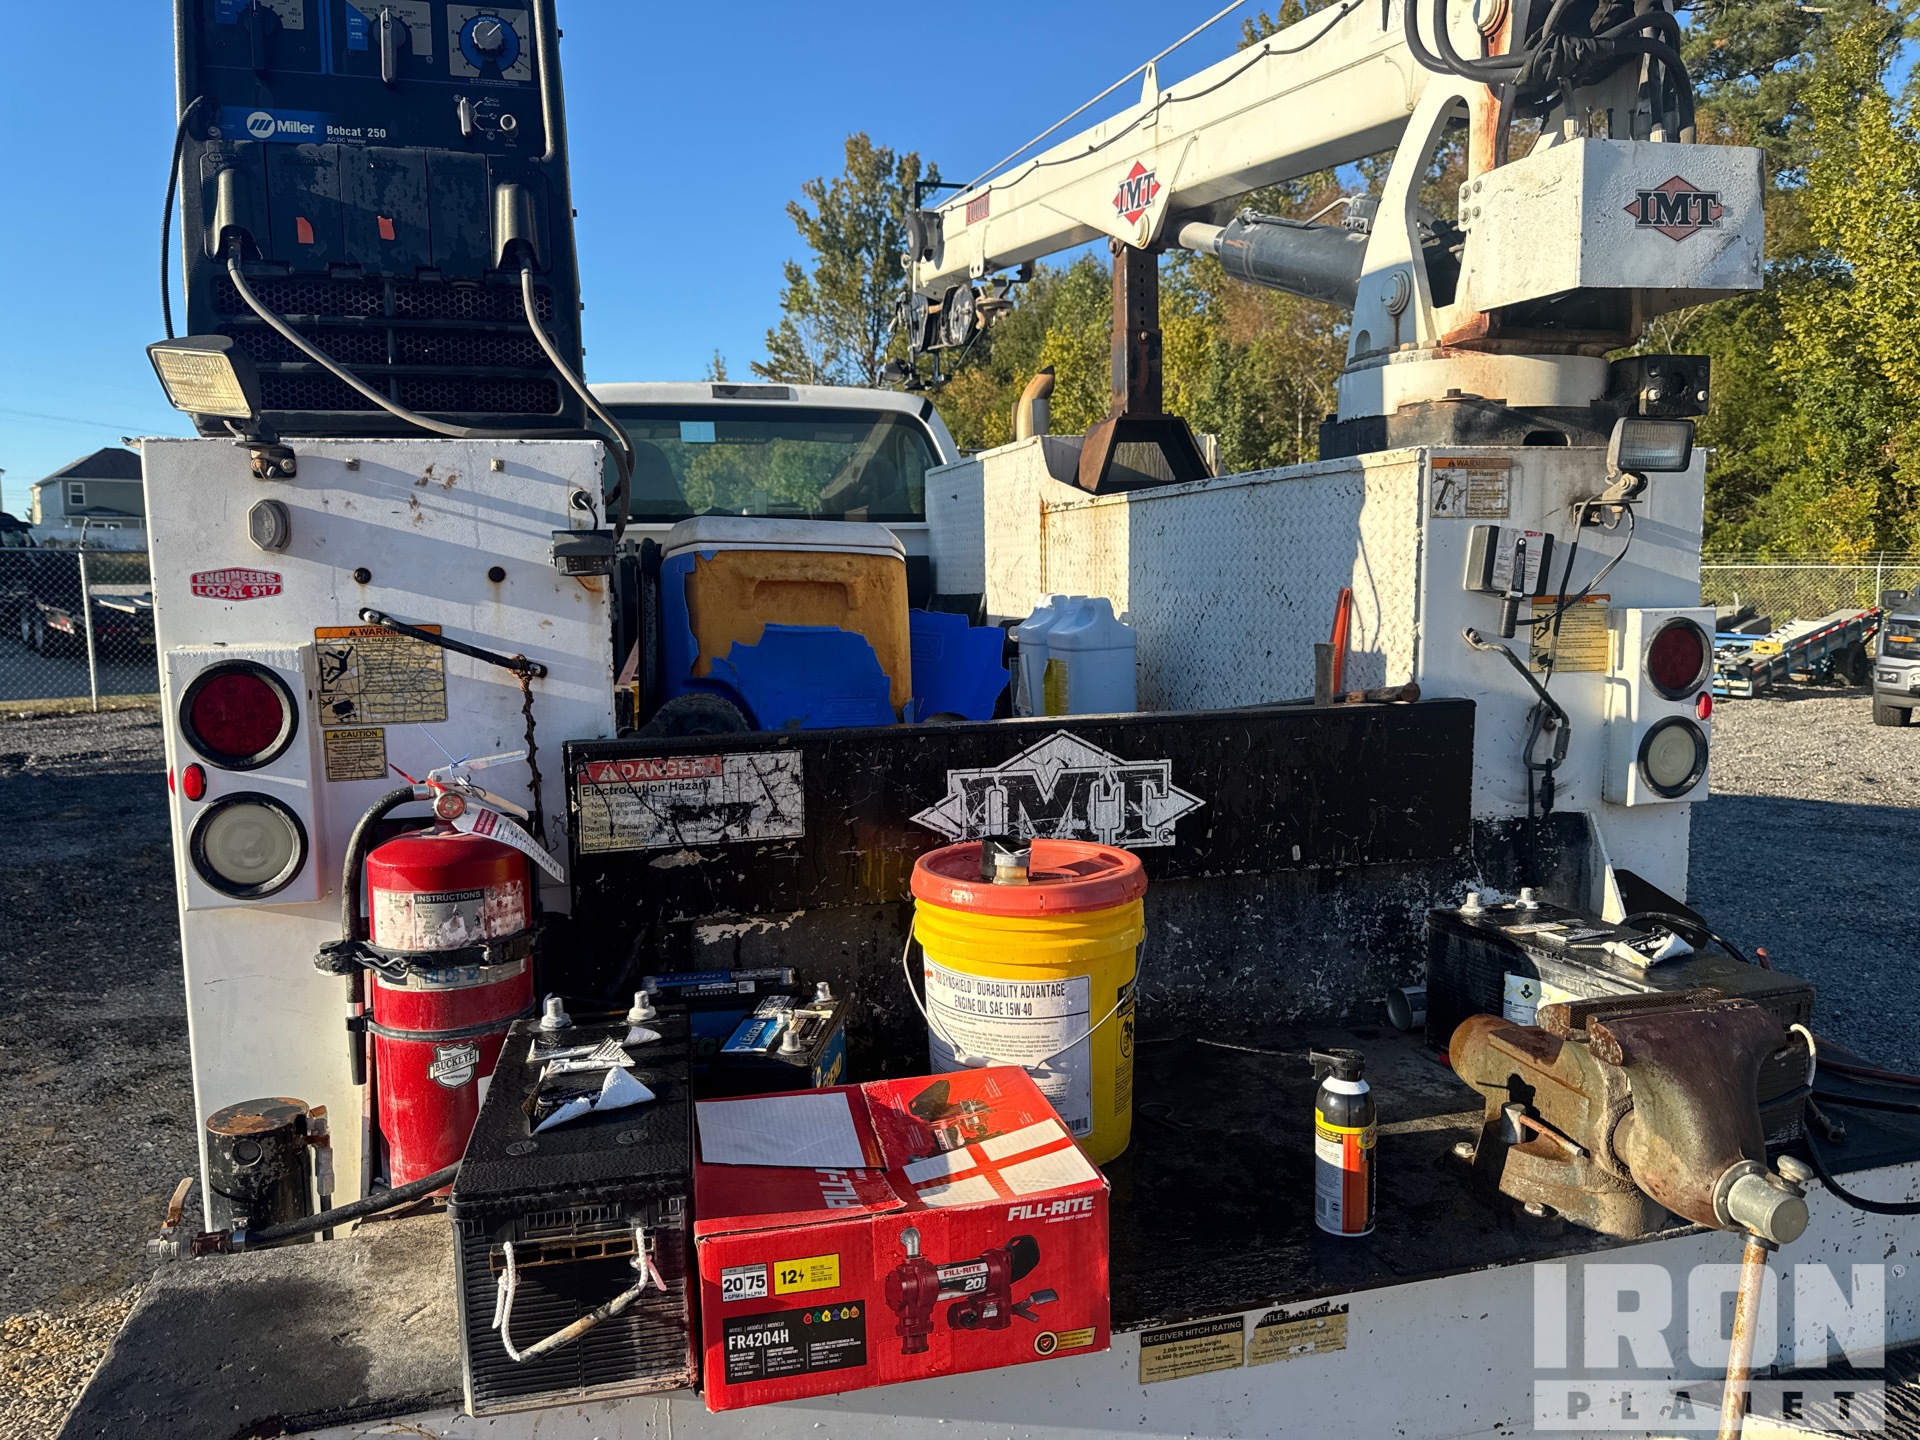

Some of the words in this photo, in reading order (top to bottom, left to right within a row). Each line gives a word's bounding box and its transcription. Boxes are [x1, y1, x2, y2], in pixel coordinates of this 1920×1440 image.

[277, 119, 315, 134] Miller
[367, 127, 387, 139] 250
[1118, 172, 1156, 215] IMT
[1637, 191, 1718, 226] IMT
[196, 569, 276, 585] ENGINEERS
[196, 585, 248, 598] LOCAL
[250, 584, 278, 597] 917
[340, 730, 378, 738] CAUTION
[621, 761, 704, 779] DANGER
[584, 825, 607, 833] Death
[416, 890, 482, 904] INSTRUCTIONS
[977, 983, 1018, 998] DURABILITY
[1020, 982, 1066, 999] ADVANTAGE
[954, 994, 976, 1013] ENGINE
[977, 999, 988, 1014] OIL
[989, 1002, 1004, 1015] SAE
[435, 1053, 475, 1072] BUCKEYE
[1007, 1195, 1094, 1222] FILL-RITE
[780, 1269, 798, 1285] 12
[943, 1264, 982, 1277] FILL-RITE
[723, 1277, 744, 1293] 20
[746, 1274, 766, 1290] 75
[965, 1277, 982, 1292] 20
[767, 1321, 785, 1329] MODELO
[1142, 1331, 1184, 1344] RECEIVER
[1185, 1326, 1210, 1338] HITCH
[1211, 1320, 1242, 1333] RATING
[728, 1329, 790, 1351] FR4204H
